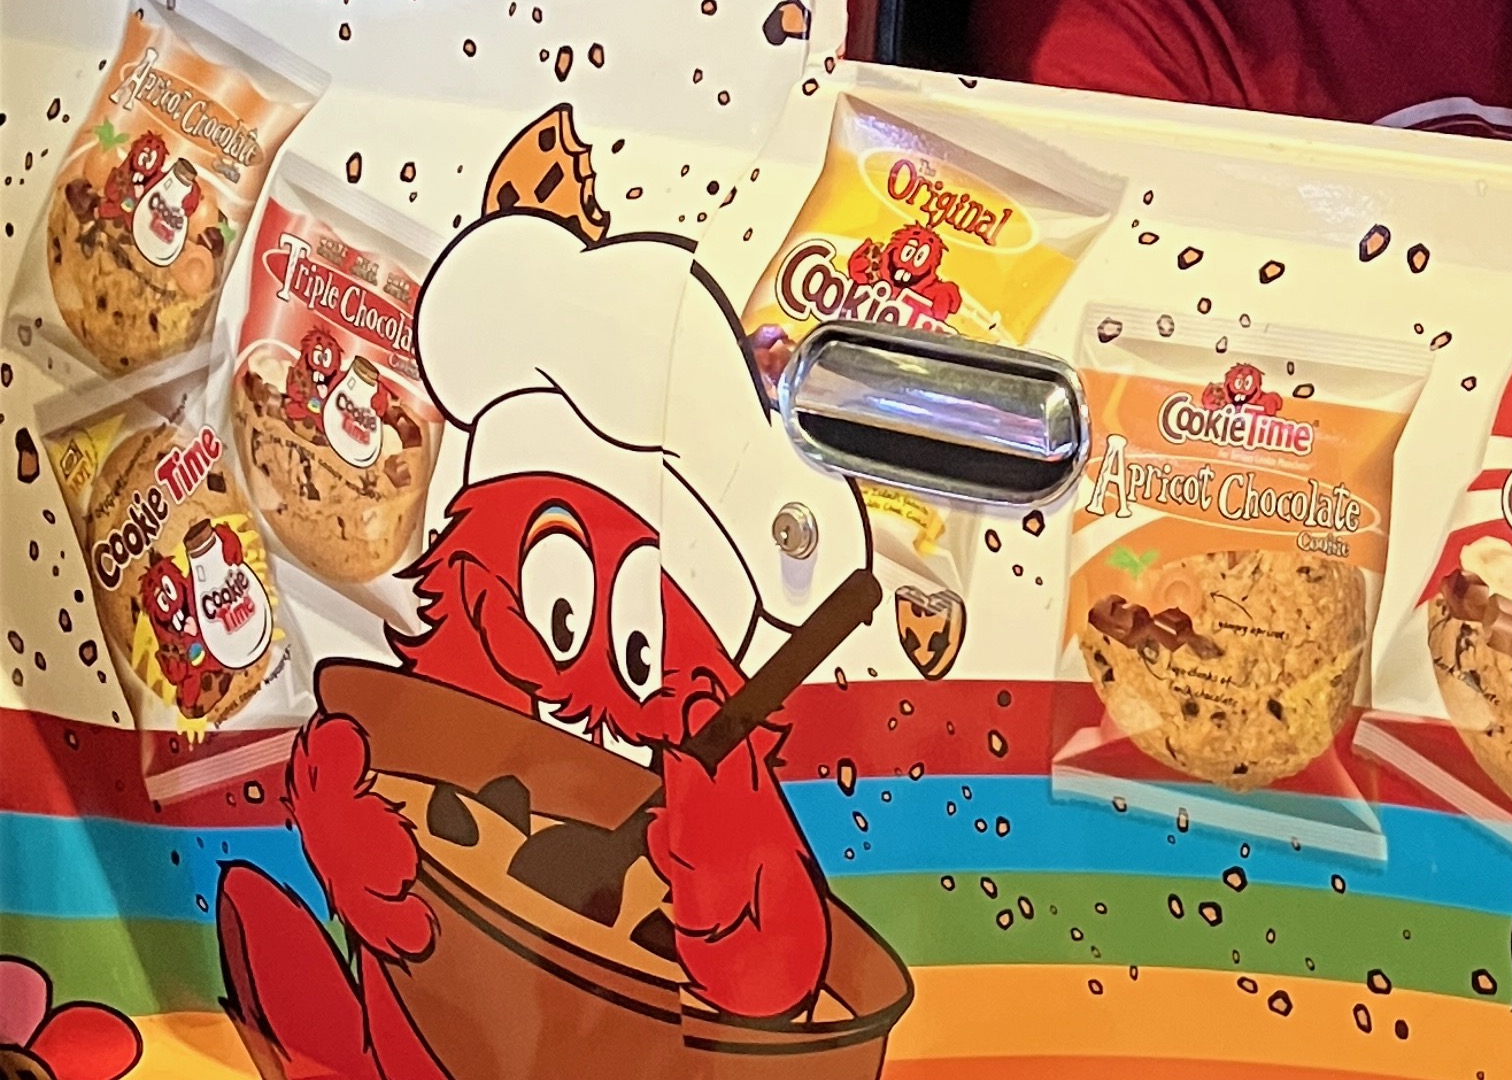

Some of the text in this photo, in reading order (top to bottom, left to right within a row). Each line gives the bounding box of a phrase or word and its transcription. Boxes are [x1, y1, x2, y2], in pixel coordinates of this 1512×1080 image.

[887, 158, 1014, 248] Original
[277, 232, 341, 311] Triple
[339, 285, 417, 357] Chocola
[93, 486, 169, 589] Cookie
[156, 427, 222, 503] Time
[1086, 434, 1361, 533] Apricot Chocolate
[202, 569, 249, 620] Cookie
[215, 596, 256, 634] Time
